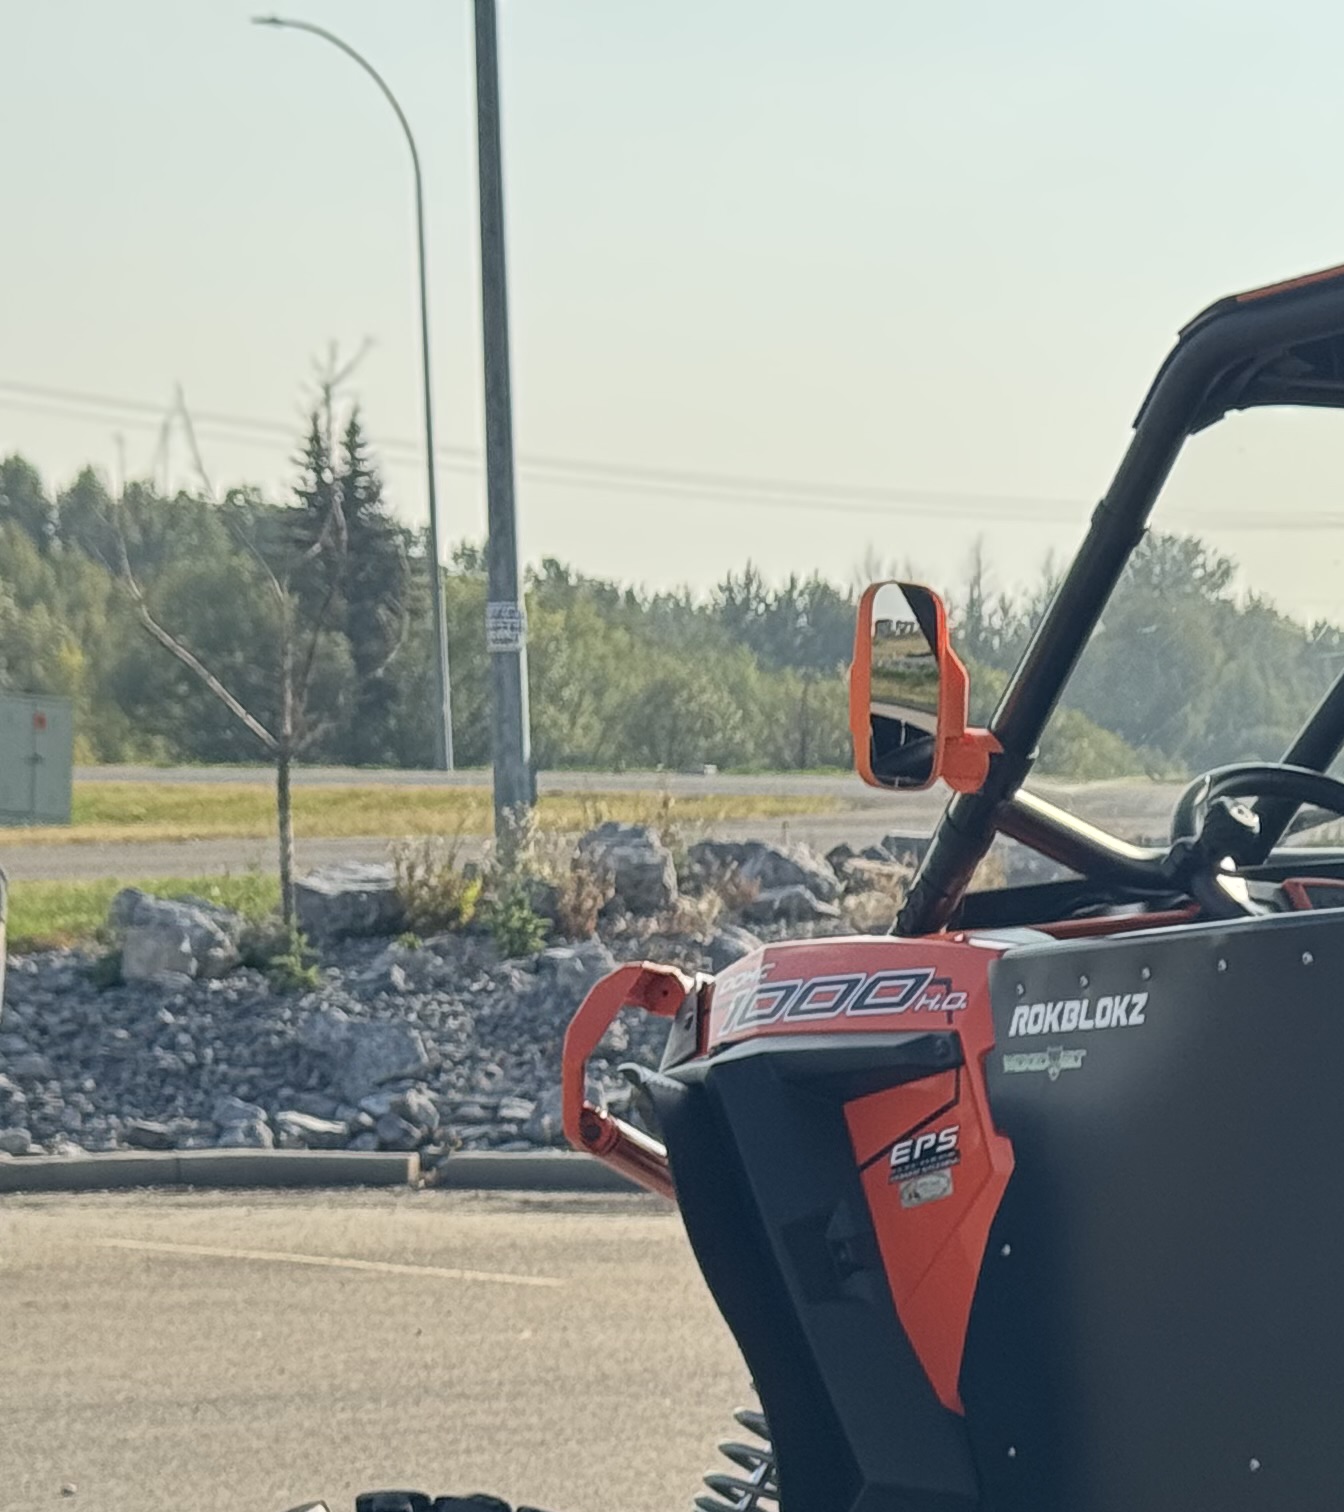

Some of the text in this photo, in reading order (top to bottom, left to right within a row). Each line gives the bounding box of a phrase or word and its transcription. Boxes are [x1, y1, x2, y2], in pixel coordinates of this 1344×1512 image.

[717, 967, 968, 1037] 1000 H.O.
[1008, 992, 1149, 1038] ROKBLOKZ
[890, 1125, 960, 1168] EPS
